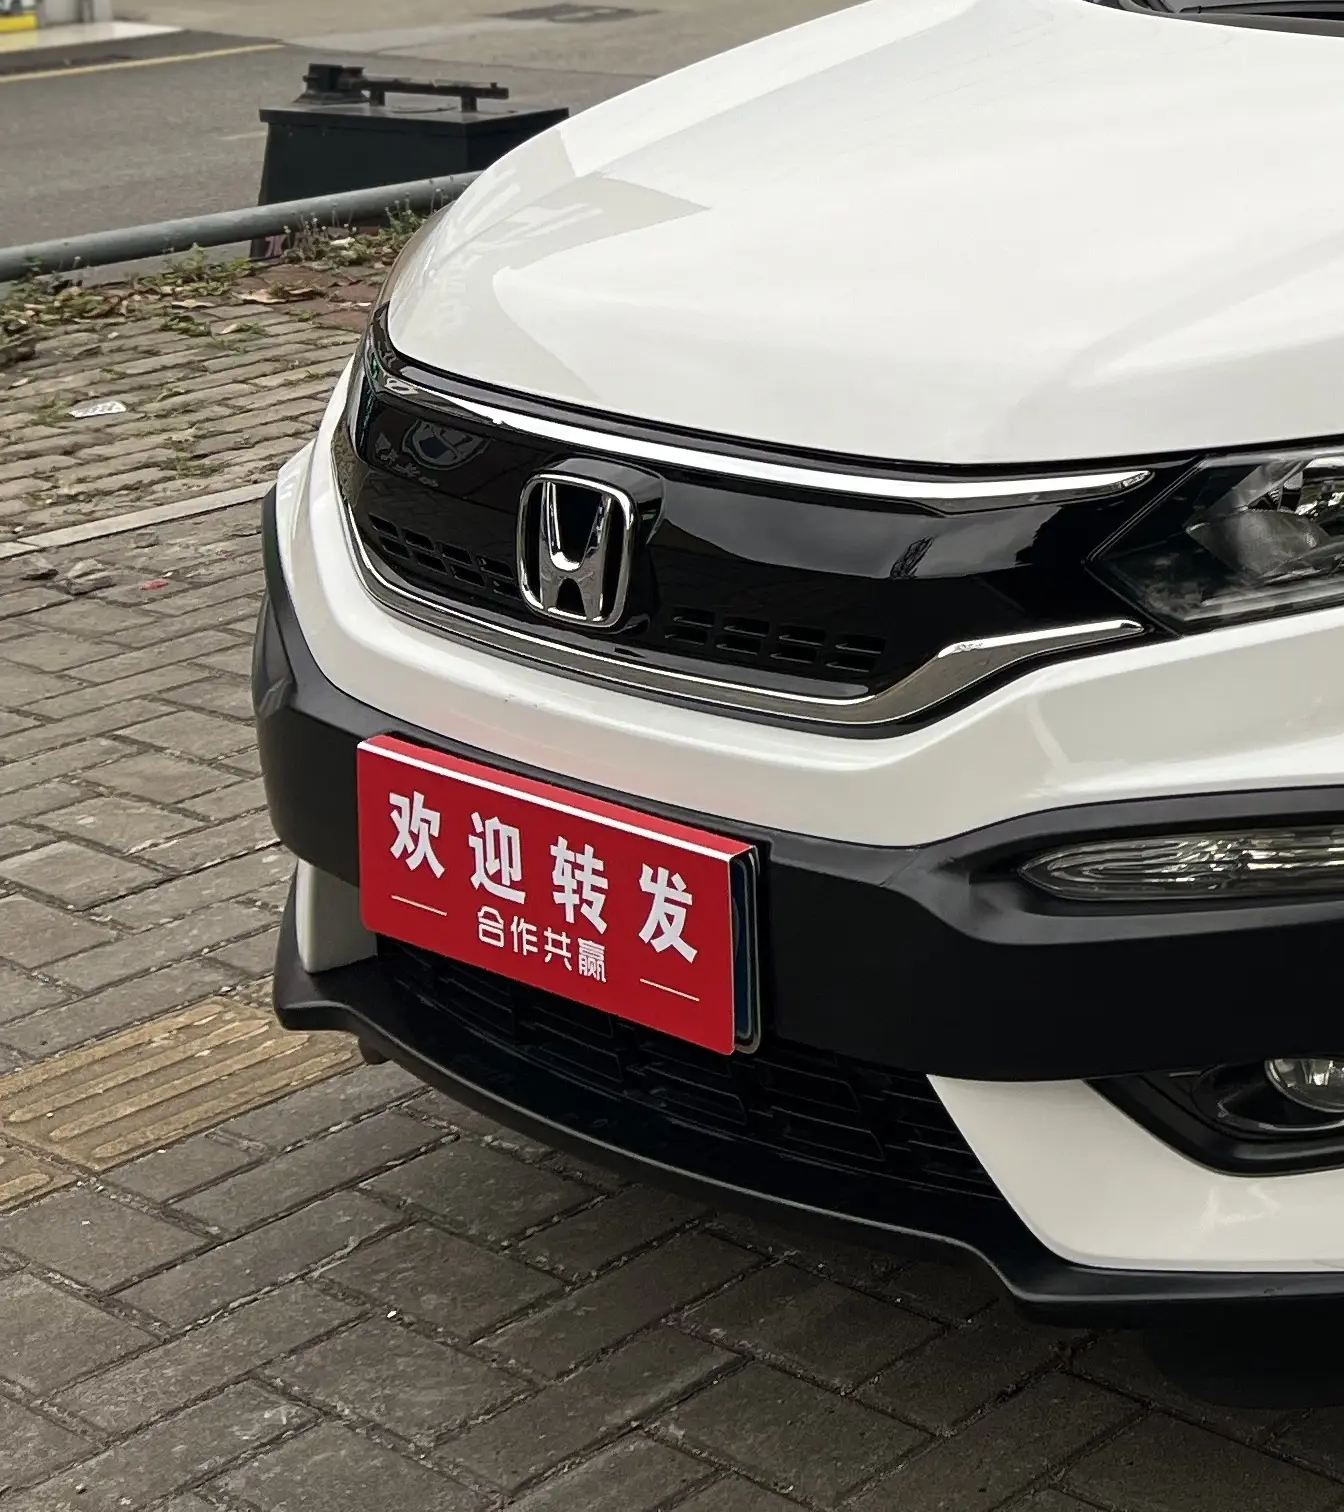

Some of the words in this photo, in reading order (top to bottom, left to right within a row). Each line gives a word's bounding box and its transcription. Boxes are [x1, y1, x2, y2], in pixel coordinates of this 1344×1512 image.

[388, 790, 699, 965] 欢迎转发
[476, 904, 608, 984] 合作共赢
